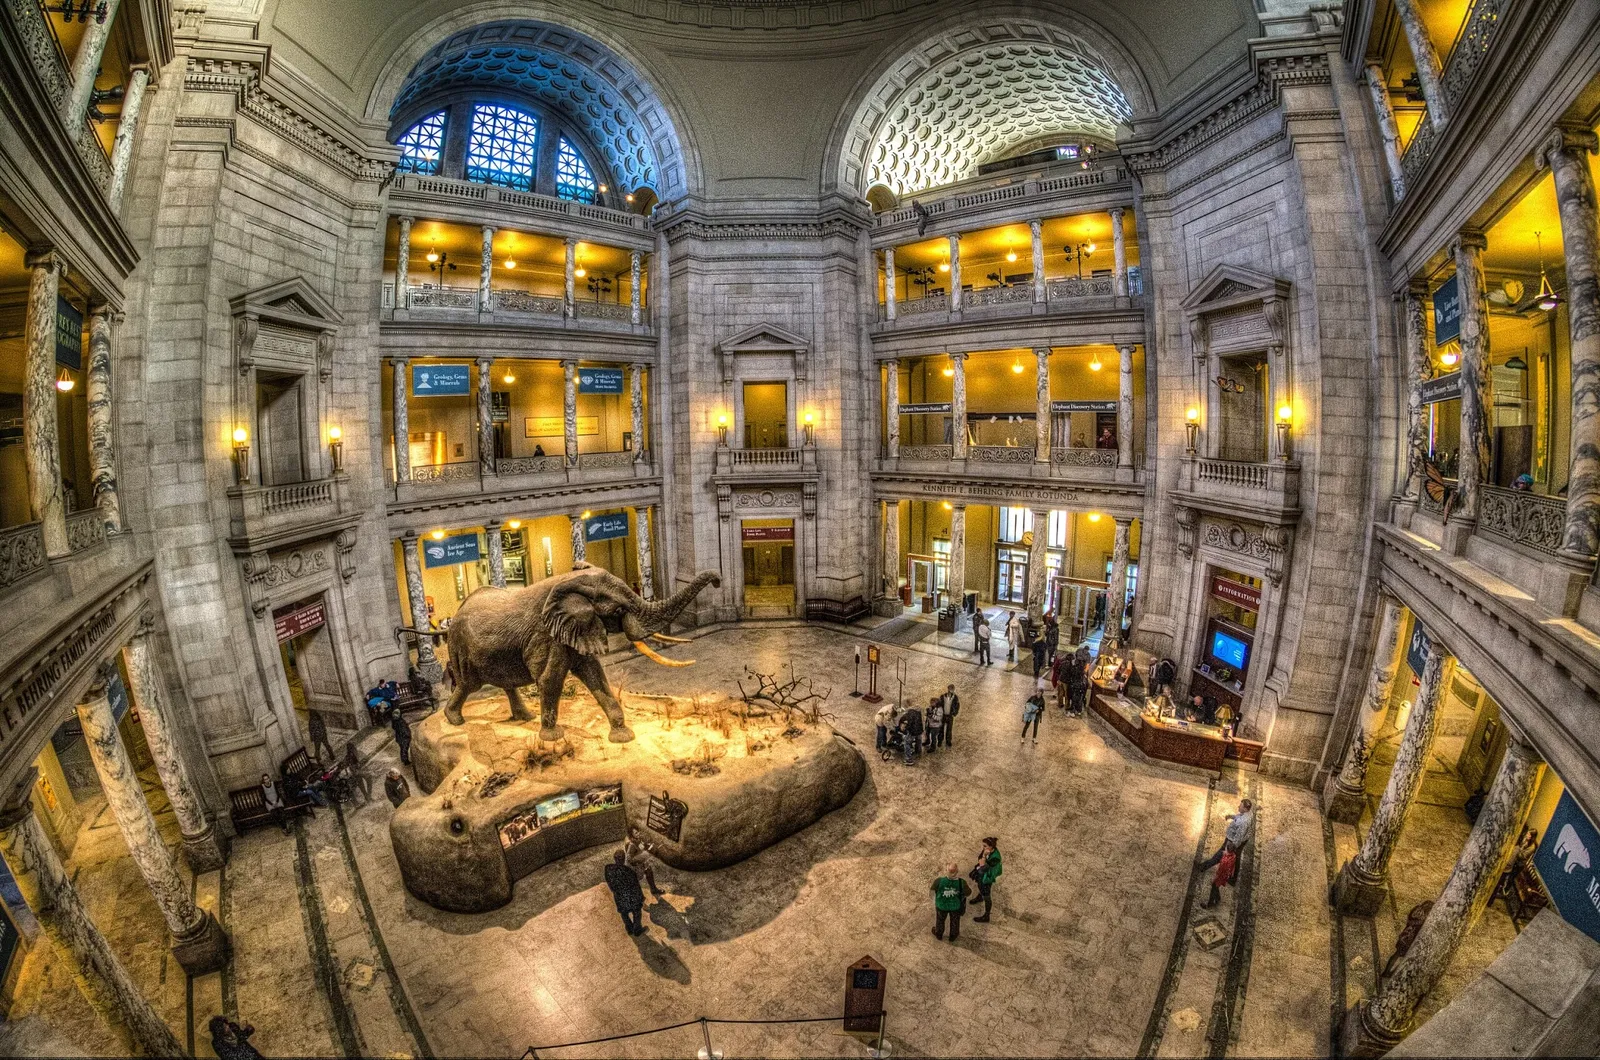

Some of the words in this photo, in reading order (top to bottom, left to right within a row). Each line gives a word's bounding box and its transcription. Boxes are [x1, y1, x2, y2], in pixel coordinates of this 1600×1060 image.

[968, 487, 1002, 496] BEHRING
[1005, 490, 1034, 498] FAMILY
[1037, 492, 1078, 500] ROTUNDA
[1223, 587, 1255, 602] INFORMATION
[3, 706, 18, 731] E.
[16, 662, 61, 717] BEHRING
[60, 641, 88, 672] FAMILY
